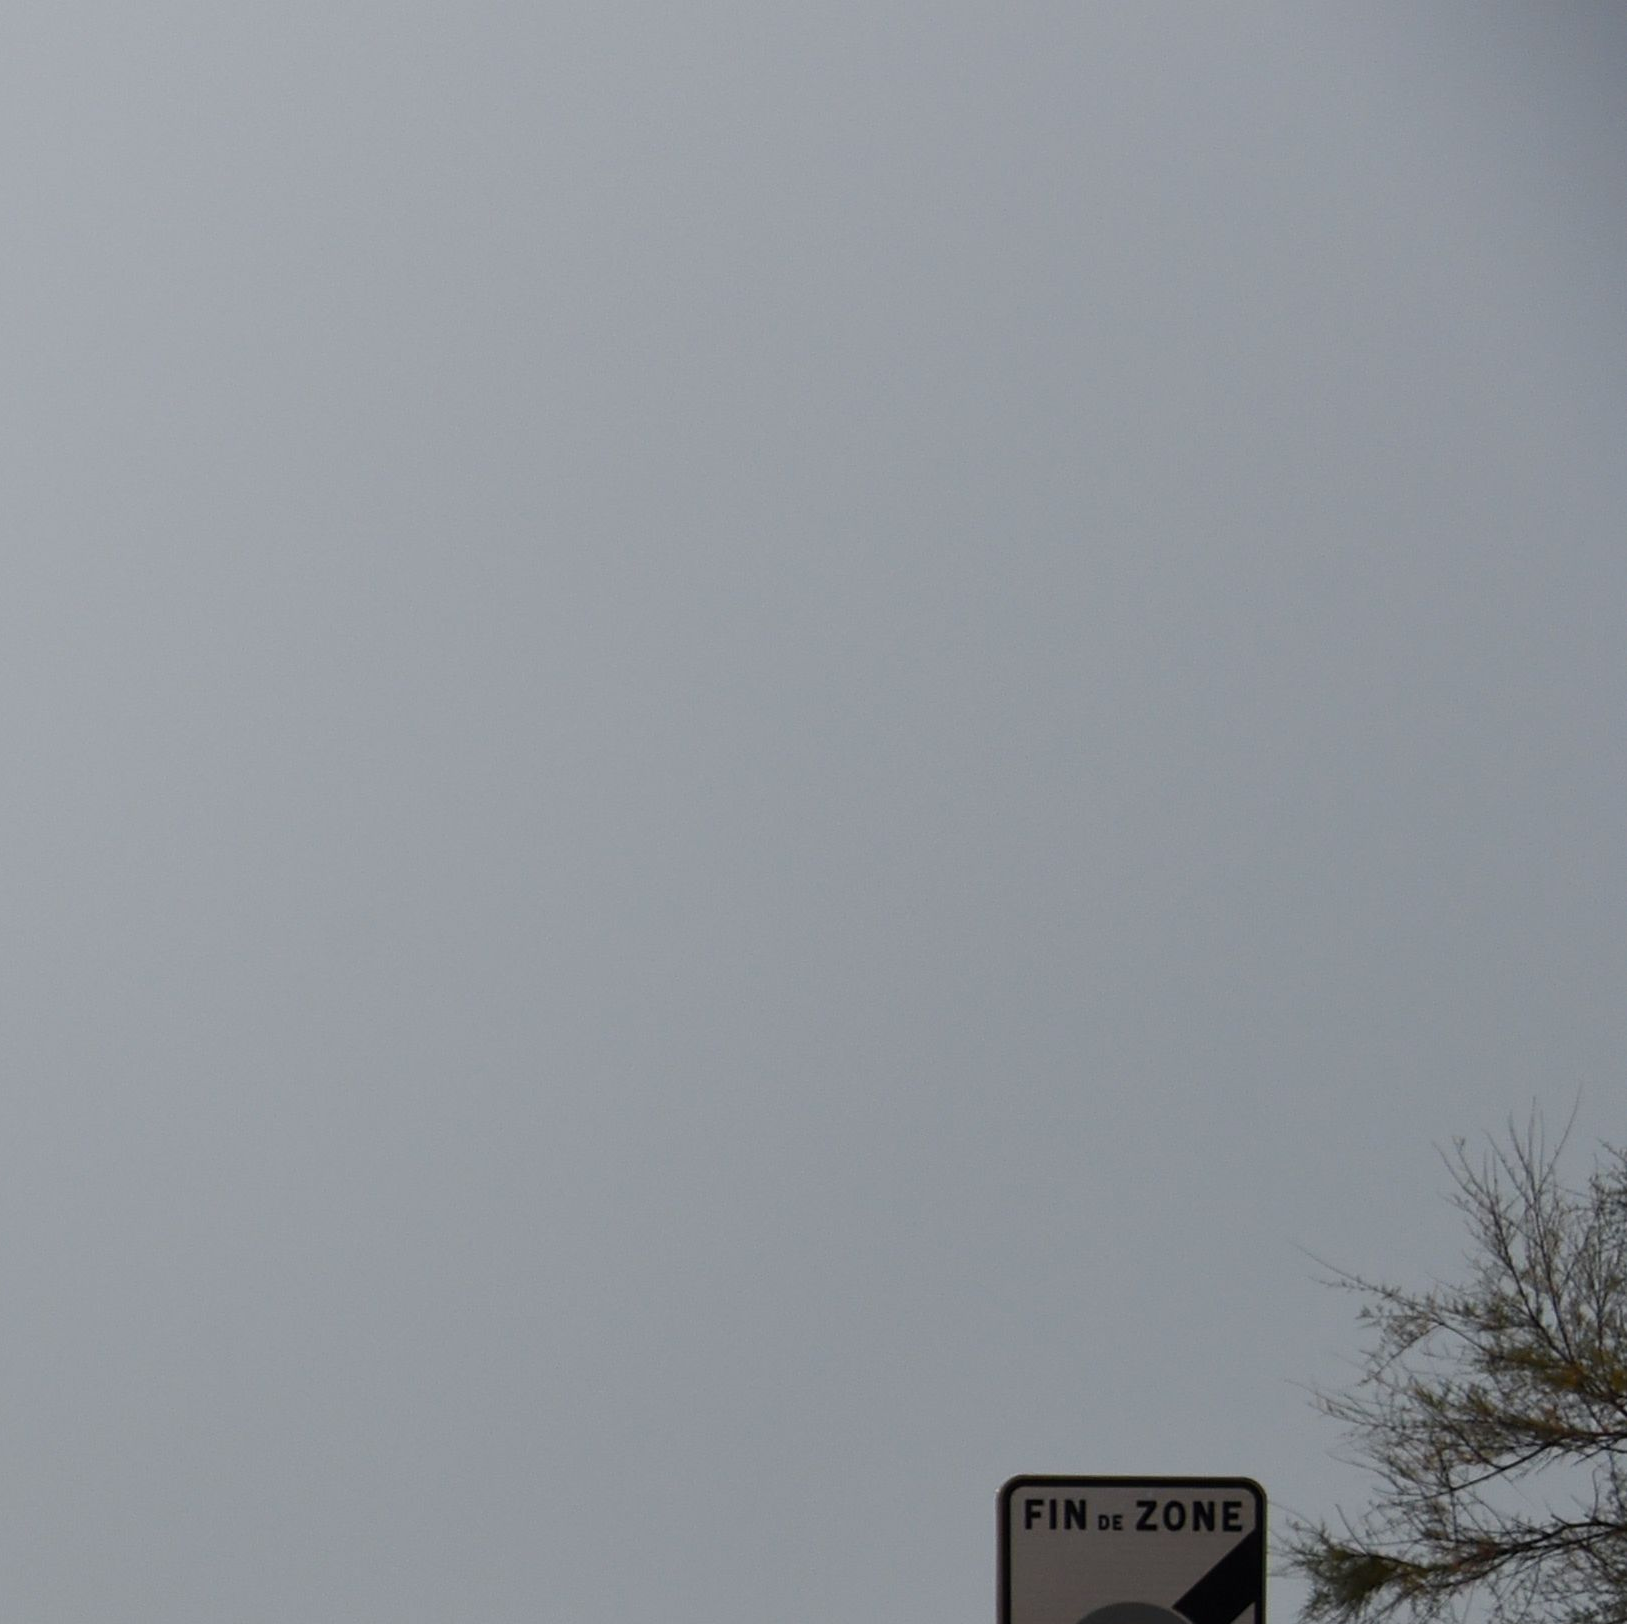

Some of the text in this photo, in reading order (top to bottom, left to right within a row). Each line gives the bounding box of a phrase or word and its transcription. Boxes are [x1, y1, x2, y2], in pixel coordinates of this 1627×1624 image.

[1024, 1499, 1244, 1532] FIN DE ZONE
